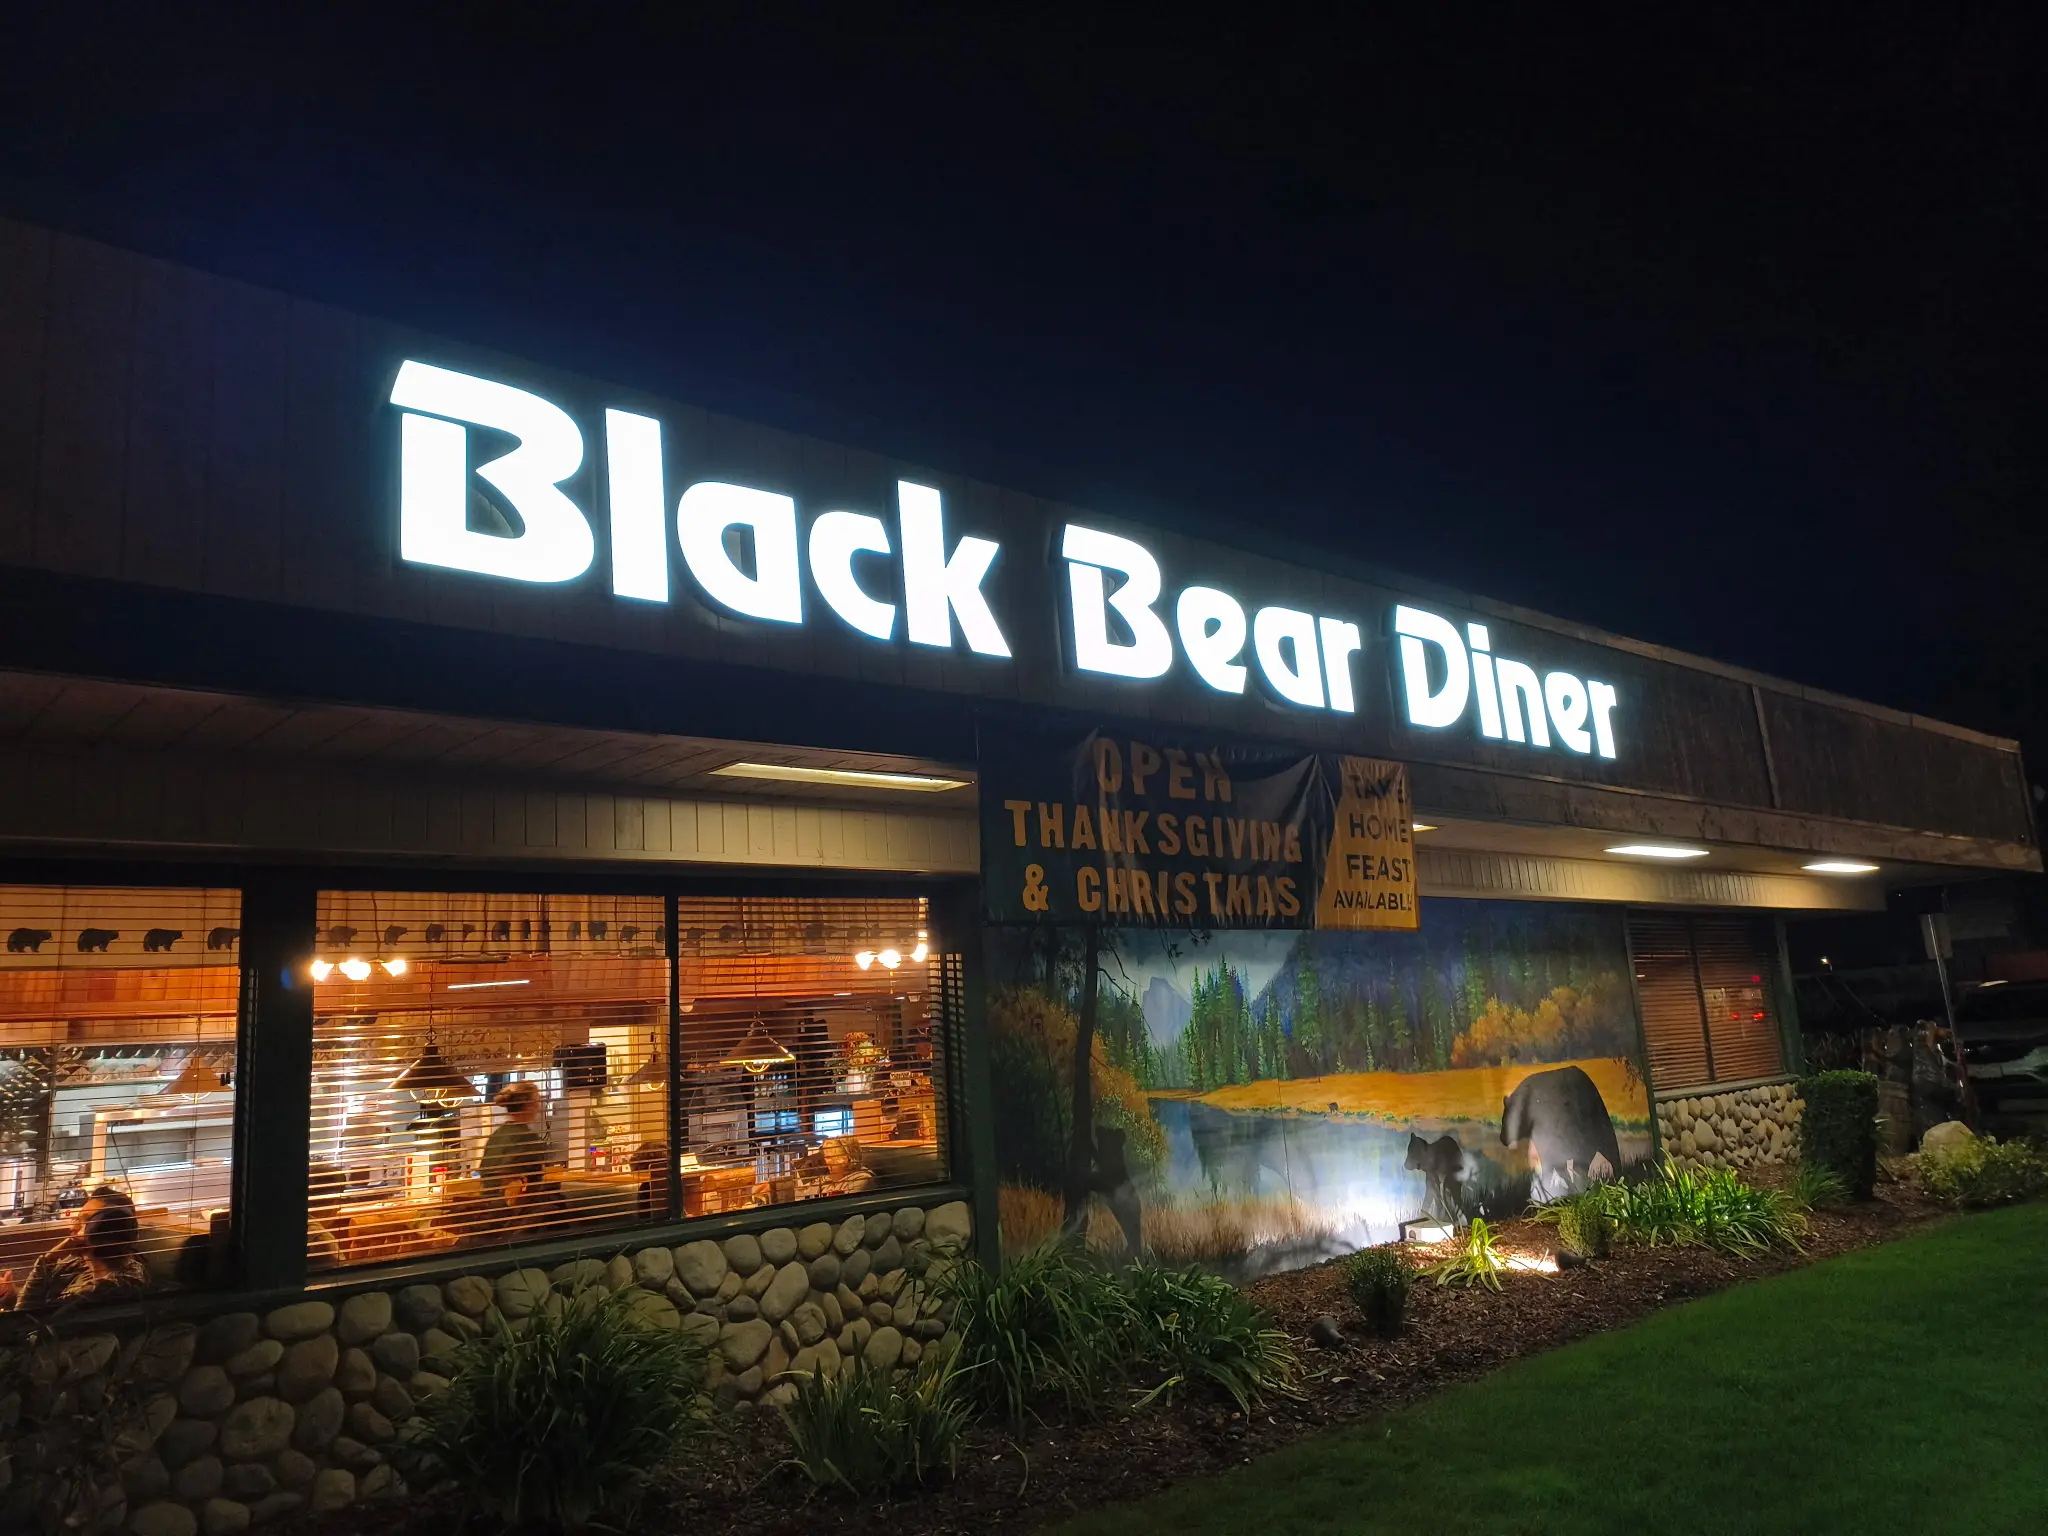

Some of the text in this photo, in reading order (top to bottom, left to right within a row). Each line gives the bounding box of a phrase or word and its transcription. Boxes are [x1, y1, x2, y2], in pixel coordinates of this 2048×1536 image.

[389, 359, 1617, 759] Black Bear Diner
[1092, 737, 1232, 803] OPEN
[1004, 799, 1302, 863] THANKSGIVING
[1349, 812, 1408, 843] HOME
[1022, 863, 1301, 918] & CHRISTMAS
[1346, 853, 1411, 883] FEAST
